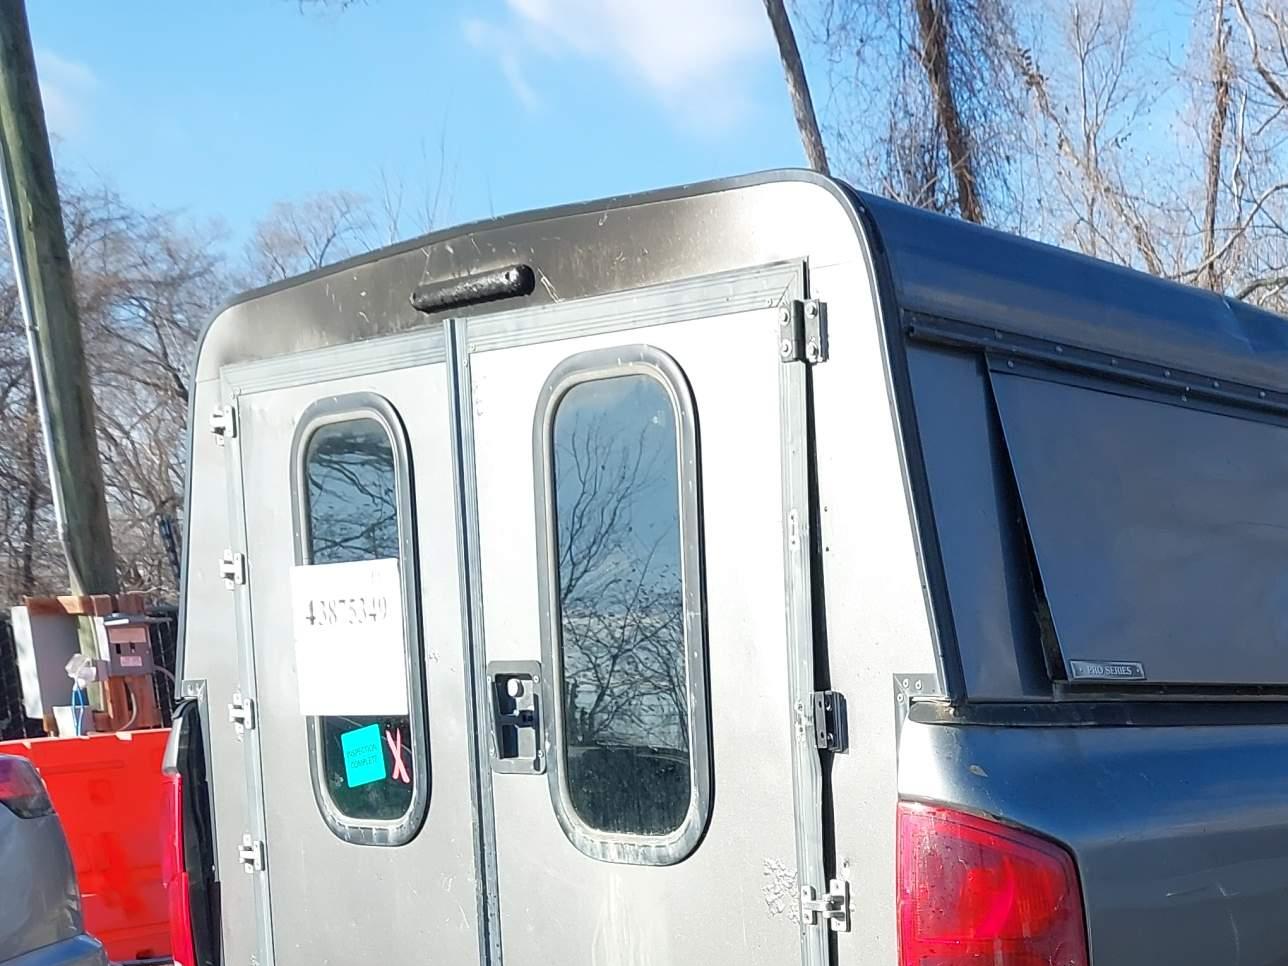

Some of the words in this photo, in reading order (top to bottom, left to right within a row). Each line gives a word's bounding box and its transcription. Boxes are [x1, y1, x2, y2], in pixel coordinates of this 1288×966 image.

[305, 596, 387, 626] 43875349
[1087, 665, 1104, 675] PRO
[1104, 665, 1132, 675] SERIES
